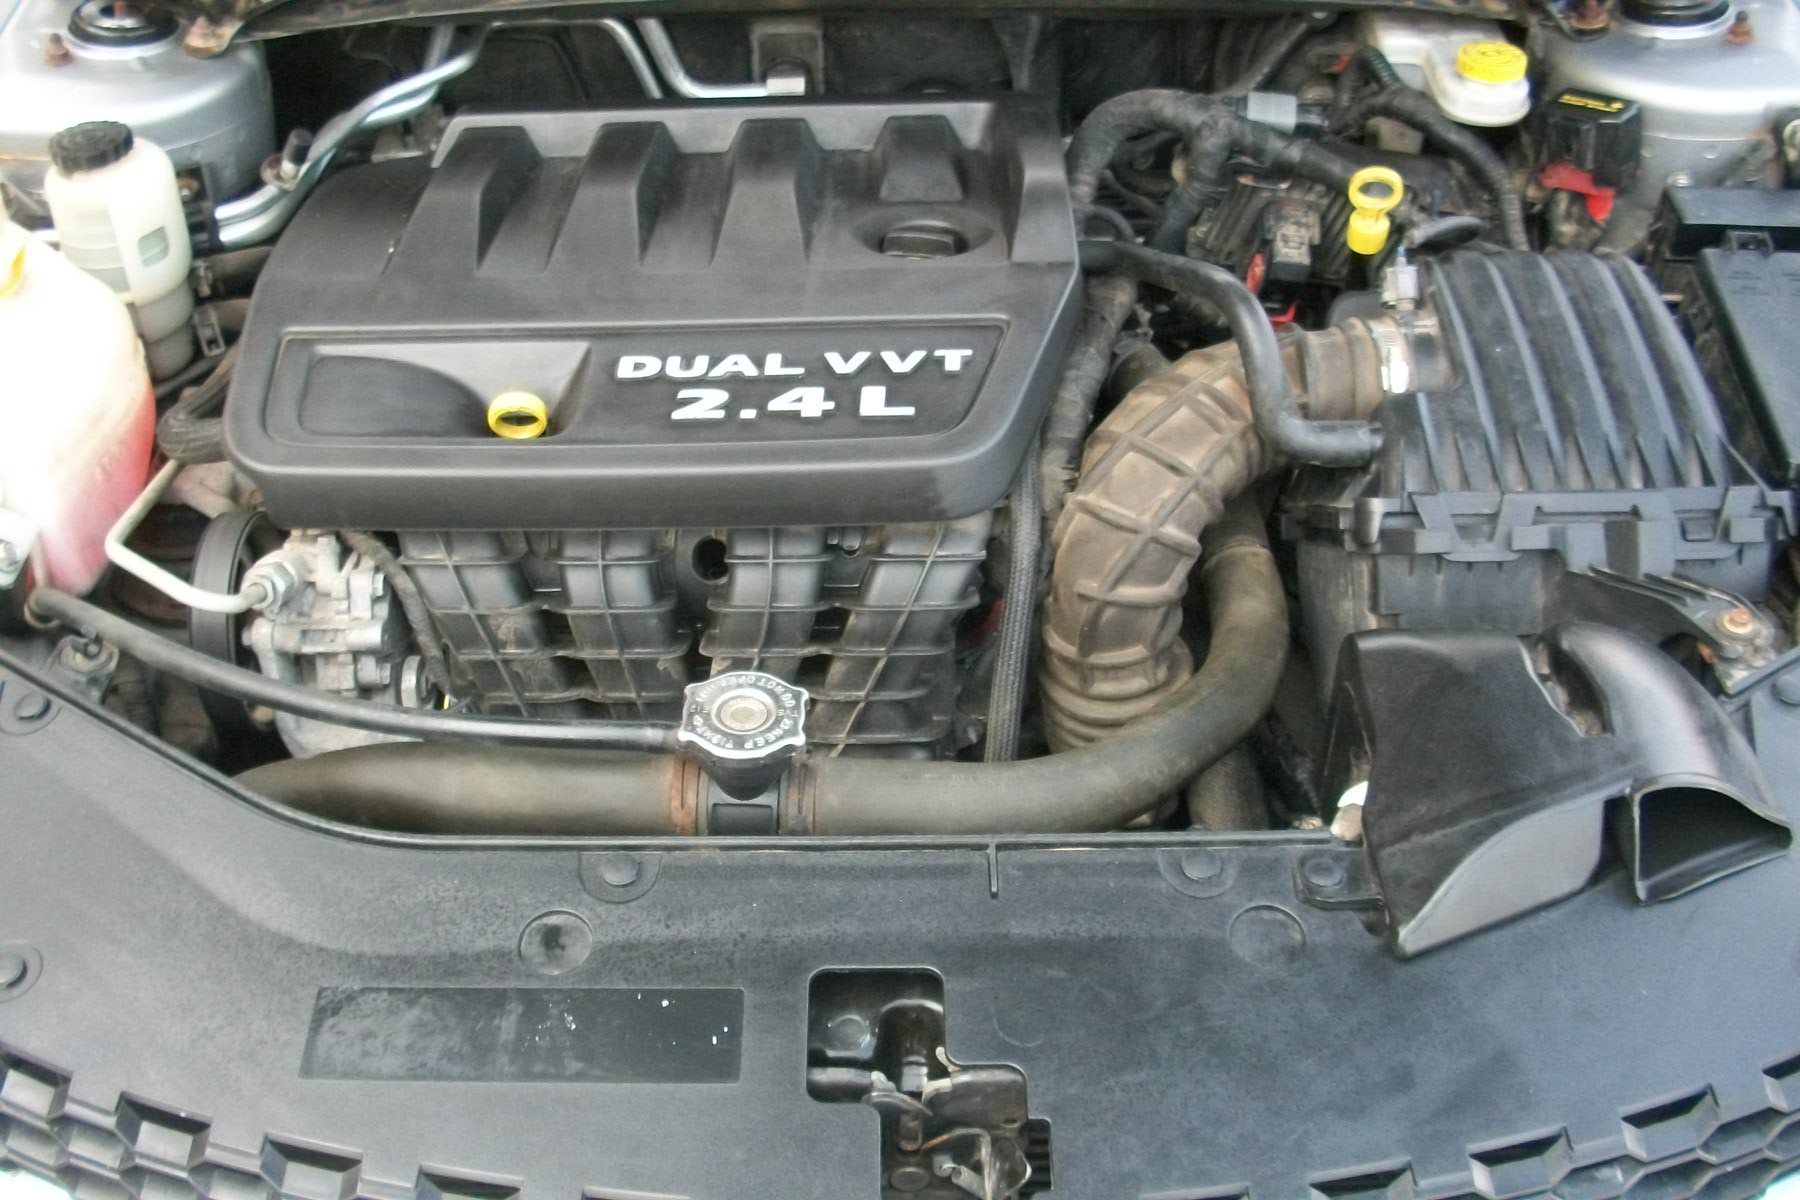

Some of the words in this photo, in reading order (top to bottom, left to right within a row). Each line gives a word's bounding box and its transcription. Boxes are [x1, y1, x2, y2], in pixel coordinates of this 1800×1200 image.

[616, 353, 805, 379] DUAL
[823, 349, 973, 374] VVT
[671, 386, 835, 419] 2.4
[859, 385, 915, 418] L
